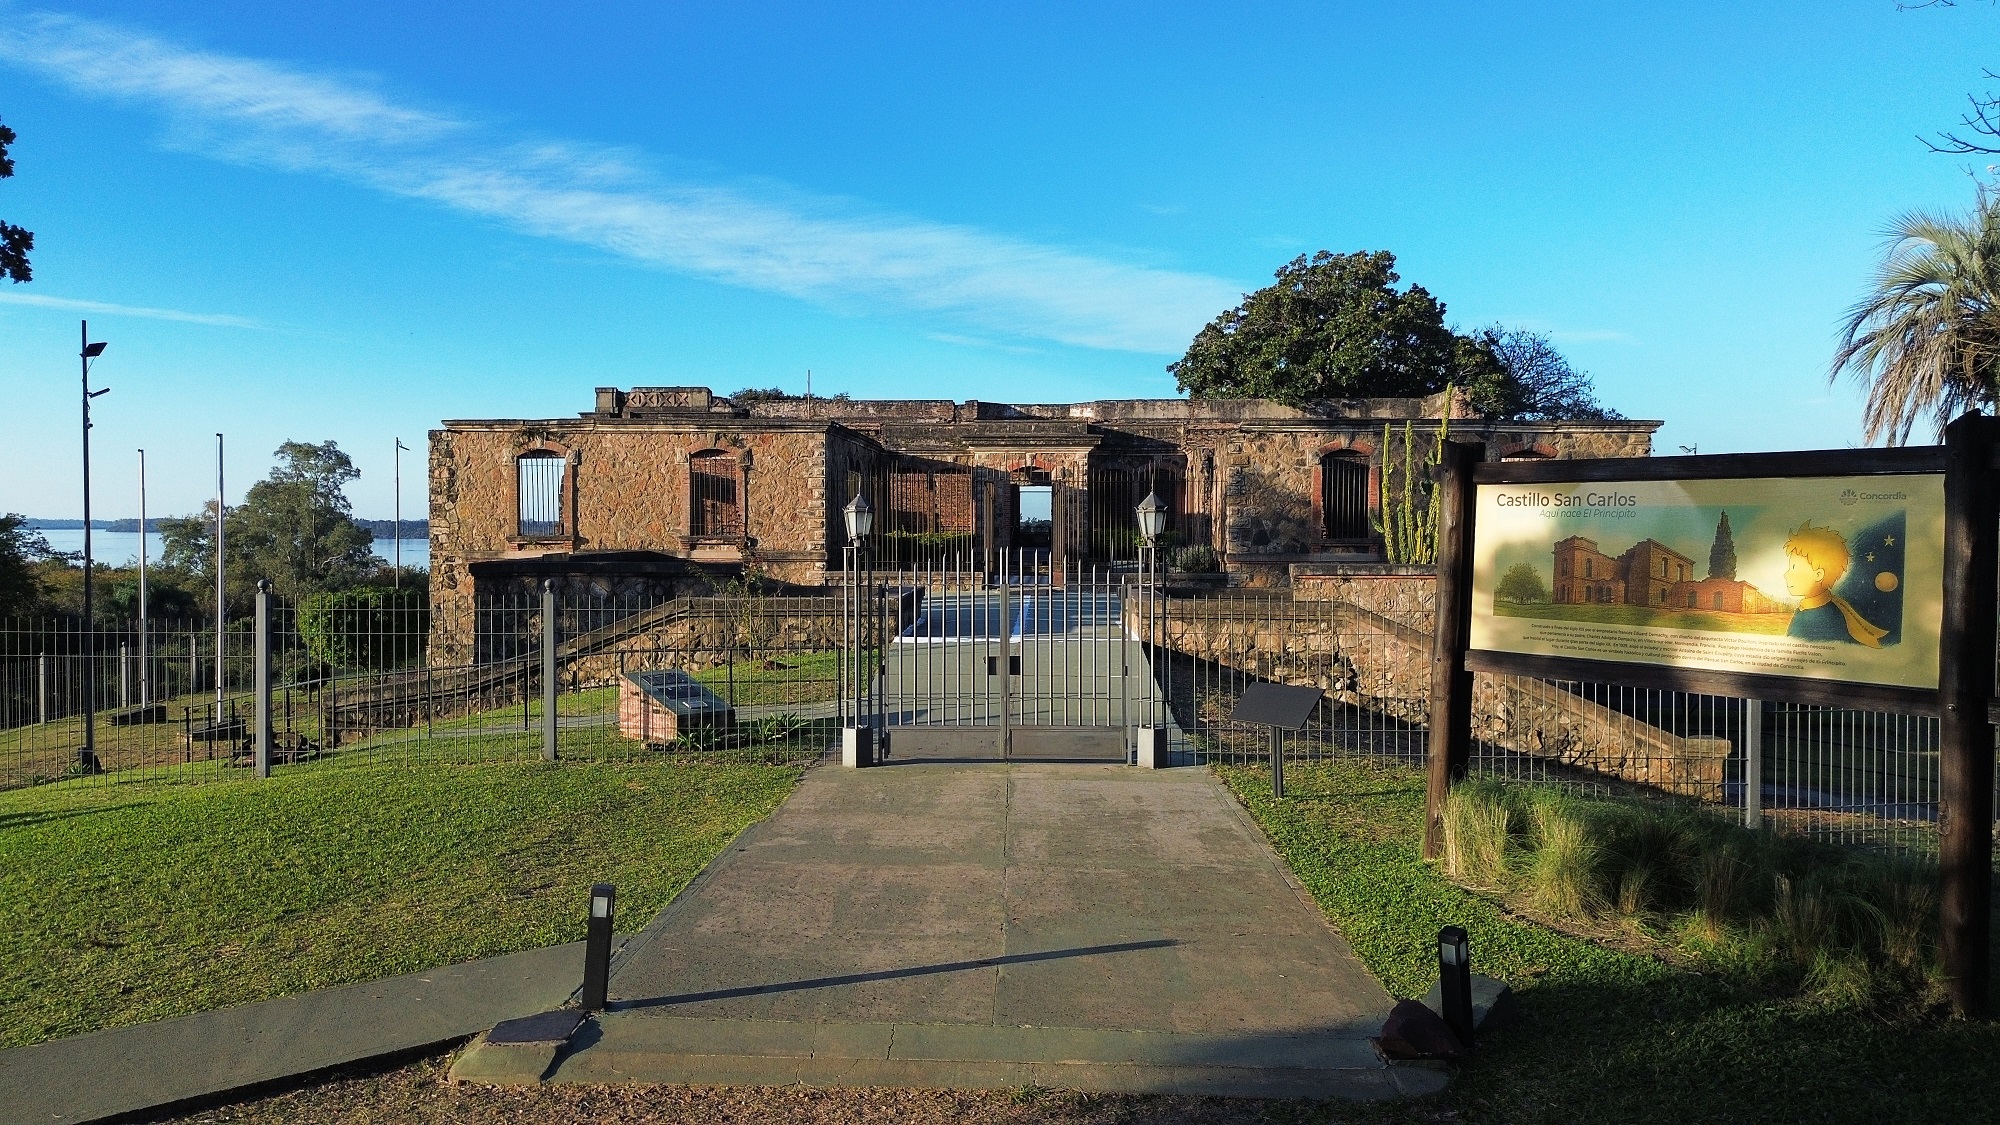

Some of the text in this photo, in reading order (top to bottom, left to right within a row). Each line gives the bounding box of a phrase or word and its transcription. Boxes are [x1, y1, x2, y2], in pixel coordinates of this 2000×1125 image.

[1496, 492, 1637, 507] Castillo San Carlos
[1860, 492, 1907, 500] Concordia
[1540, 509, 1637, 519] Aquí nace El Principito
